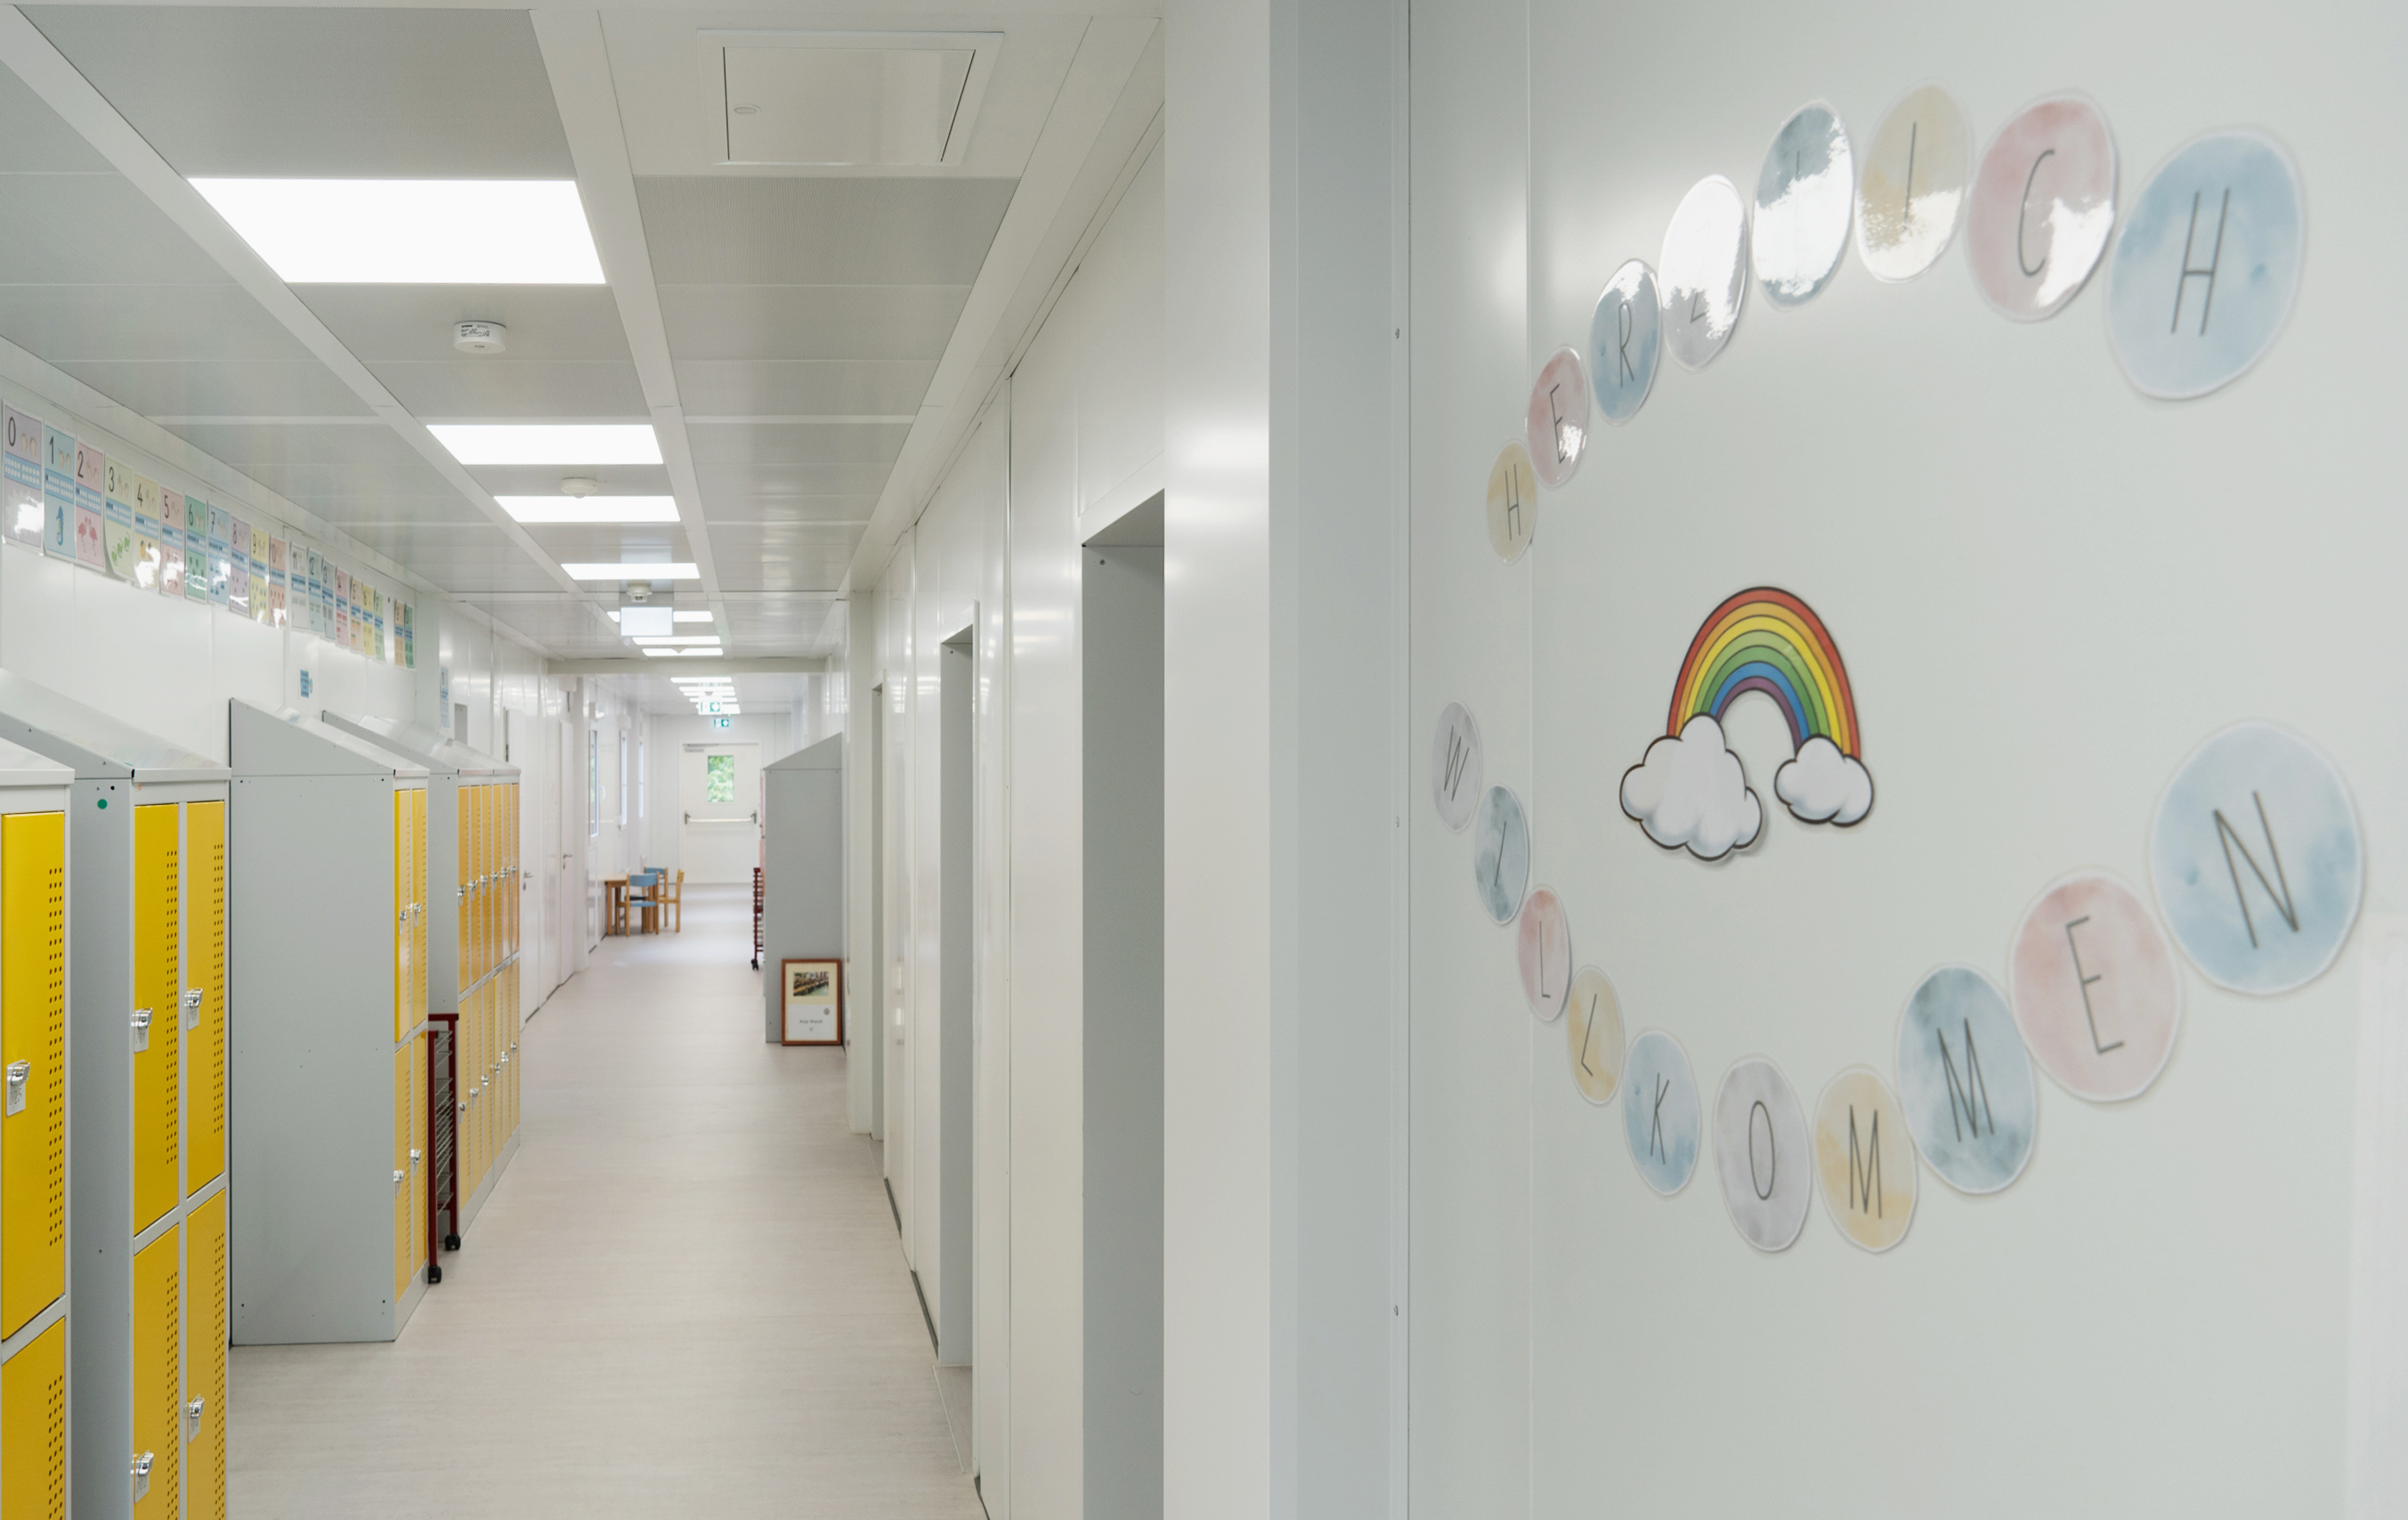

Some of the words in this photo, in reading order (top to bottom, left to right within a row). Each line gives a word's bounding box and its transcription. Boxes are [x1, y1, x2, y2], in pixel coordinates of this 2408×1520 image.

[1504, 121, 2230, 541] HERICH
[8, 417, 16, 447] 0
[50, 435, 53, 465] 1
[77, 451, 84, 478] 2
[109, 466, 114, 492] 3
[137, 484, 143, 508] 4
[164, 494, 170, 519] 5
[189, 503, 193, 526] 6
[211, 511, 215, 533] 7
[232, 523, 238, 544] 8
[253, 533, 257, 554] 9
[1443, 725, 2300, 1220] WILLKOMMEN
